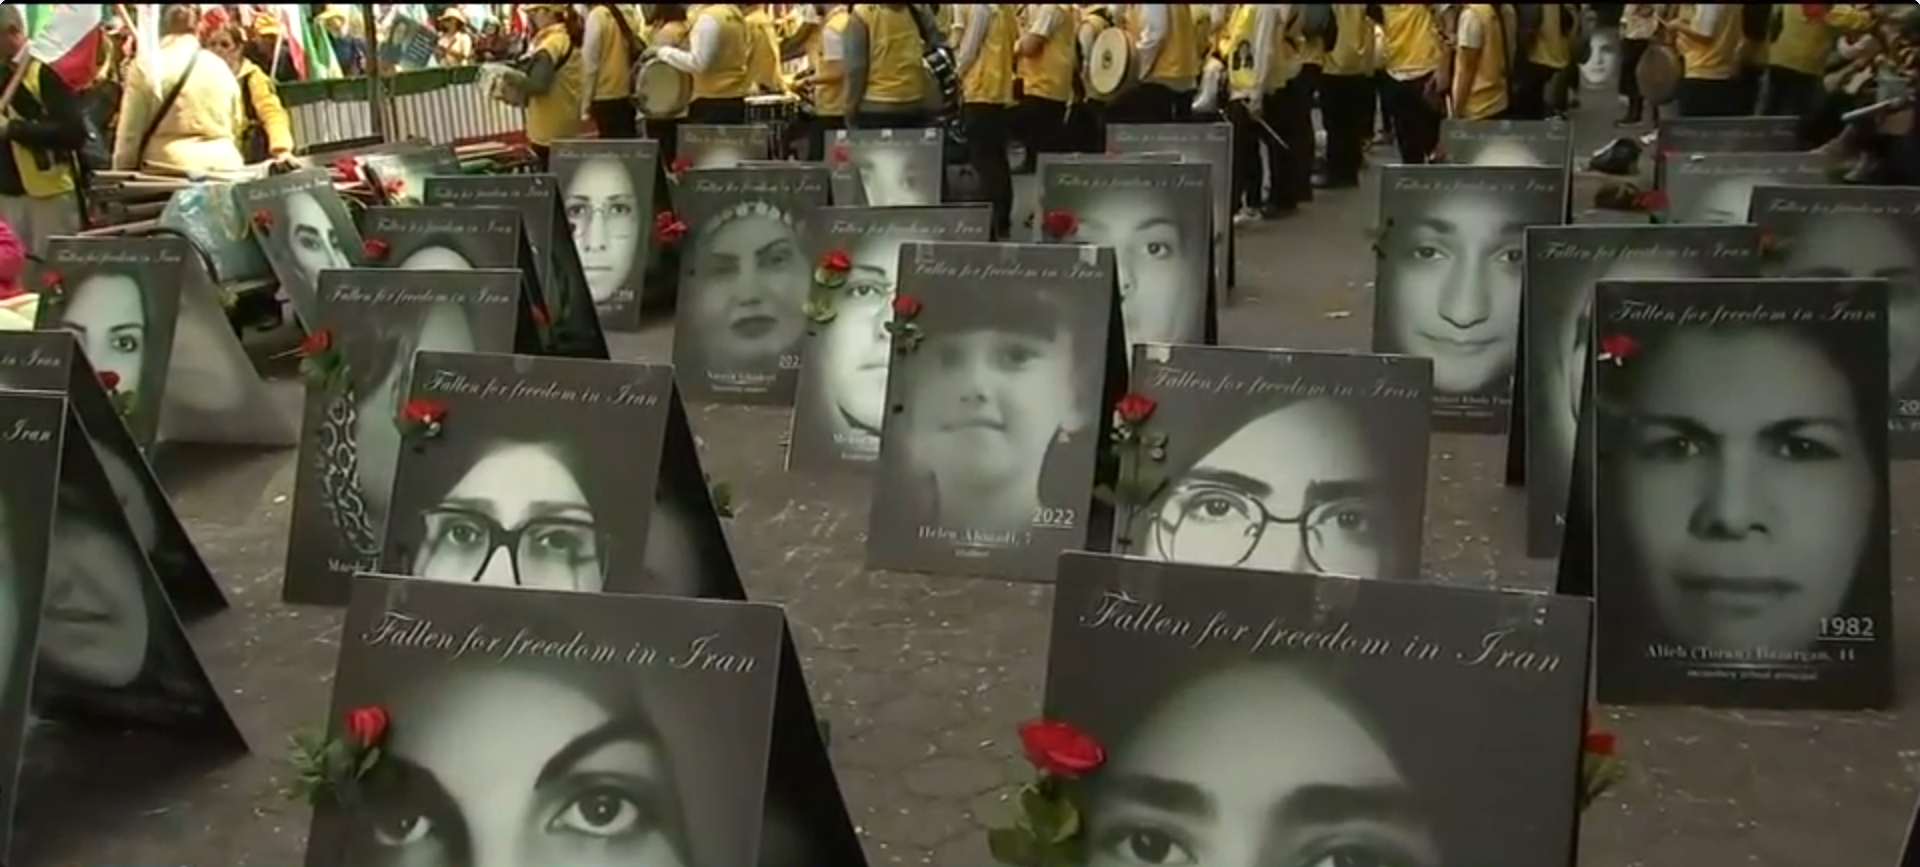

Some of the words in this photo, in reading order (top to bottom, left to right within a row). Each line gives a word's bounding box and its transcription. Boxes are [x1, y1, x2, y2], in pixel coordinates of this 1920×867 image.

[830, 219, 863, 235] Fallen
[952, 219, 983, 235] Iran
[1538, 241, 1590, 260] Fallen
[1593, 245, 1615, 261] for
[1616, 243, 1677, 262] freedom
[1682, 246, 1698, 258] in
[1702, 241, 1751, 258] Iran
[915, 259, 956, 278] Fallen
[957, 262, 980, 280] for
[981, 263, 1038, 280] freedom
[1042, 265, 1058, 278] in
[1064, 262, 1105, 279] Iran
[326, 284, 371, 303] Fallen
[372, 287, 393, 305] for
[394, 288, 448, 305] freedom
[452, 290, 465, 302] in
[470, 285, 510, 303] Iran
[1610, 299, 1675, 322] Fallen
[1677, 304, 1708, 326] for
[1708, 304, 1787, 328] freedom
[1793, 307, 1814, 322] in
[1818, 301, 1877, 322] Iran
[20, 347, 61, 366] Iran
[423, 369, 480, 394] Fallen
[480, 376, 509, 399] for
[509, 378, 578, 402] freedom
[581, 387, 601, 403] in
[606, 382, 659, 407] Iran
[1150, 365, 1213, 390] Fallen
[1214, 373, 1245, 394] for
[1248, 375, 1326, 398] freedom
[1332, 382, 1354, 397] in
[1360, 376, 1421, 400] Iran
[2, 417, 52, 441] Iran
[1031, 507, 1075, 526] 2022
[1079, 589, 1193, 637] Fallen
[1192, 609, 1250, 649] for
[1250, 614, 1392, 658] freedom
[1401, 633, 1441, 661] in
[1455, 625, 1563, 673] Iran
[1818, 616, 1875, 637] 1982
[361, 610, 455, 650] Fallen
[452, 622, 502, 662] for
[499, 627, 618, 664] freedom
[626, 641, 657, 666] in
[668, 632, 759, 674] Iran
